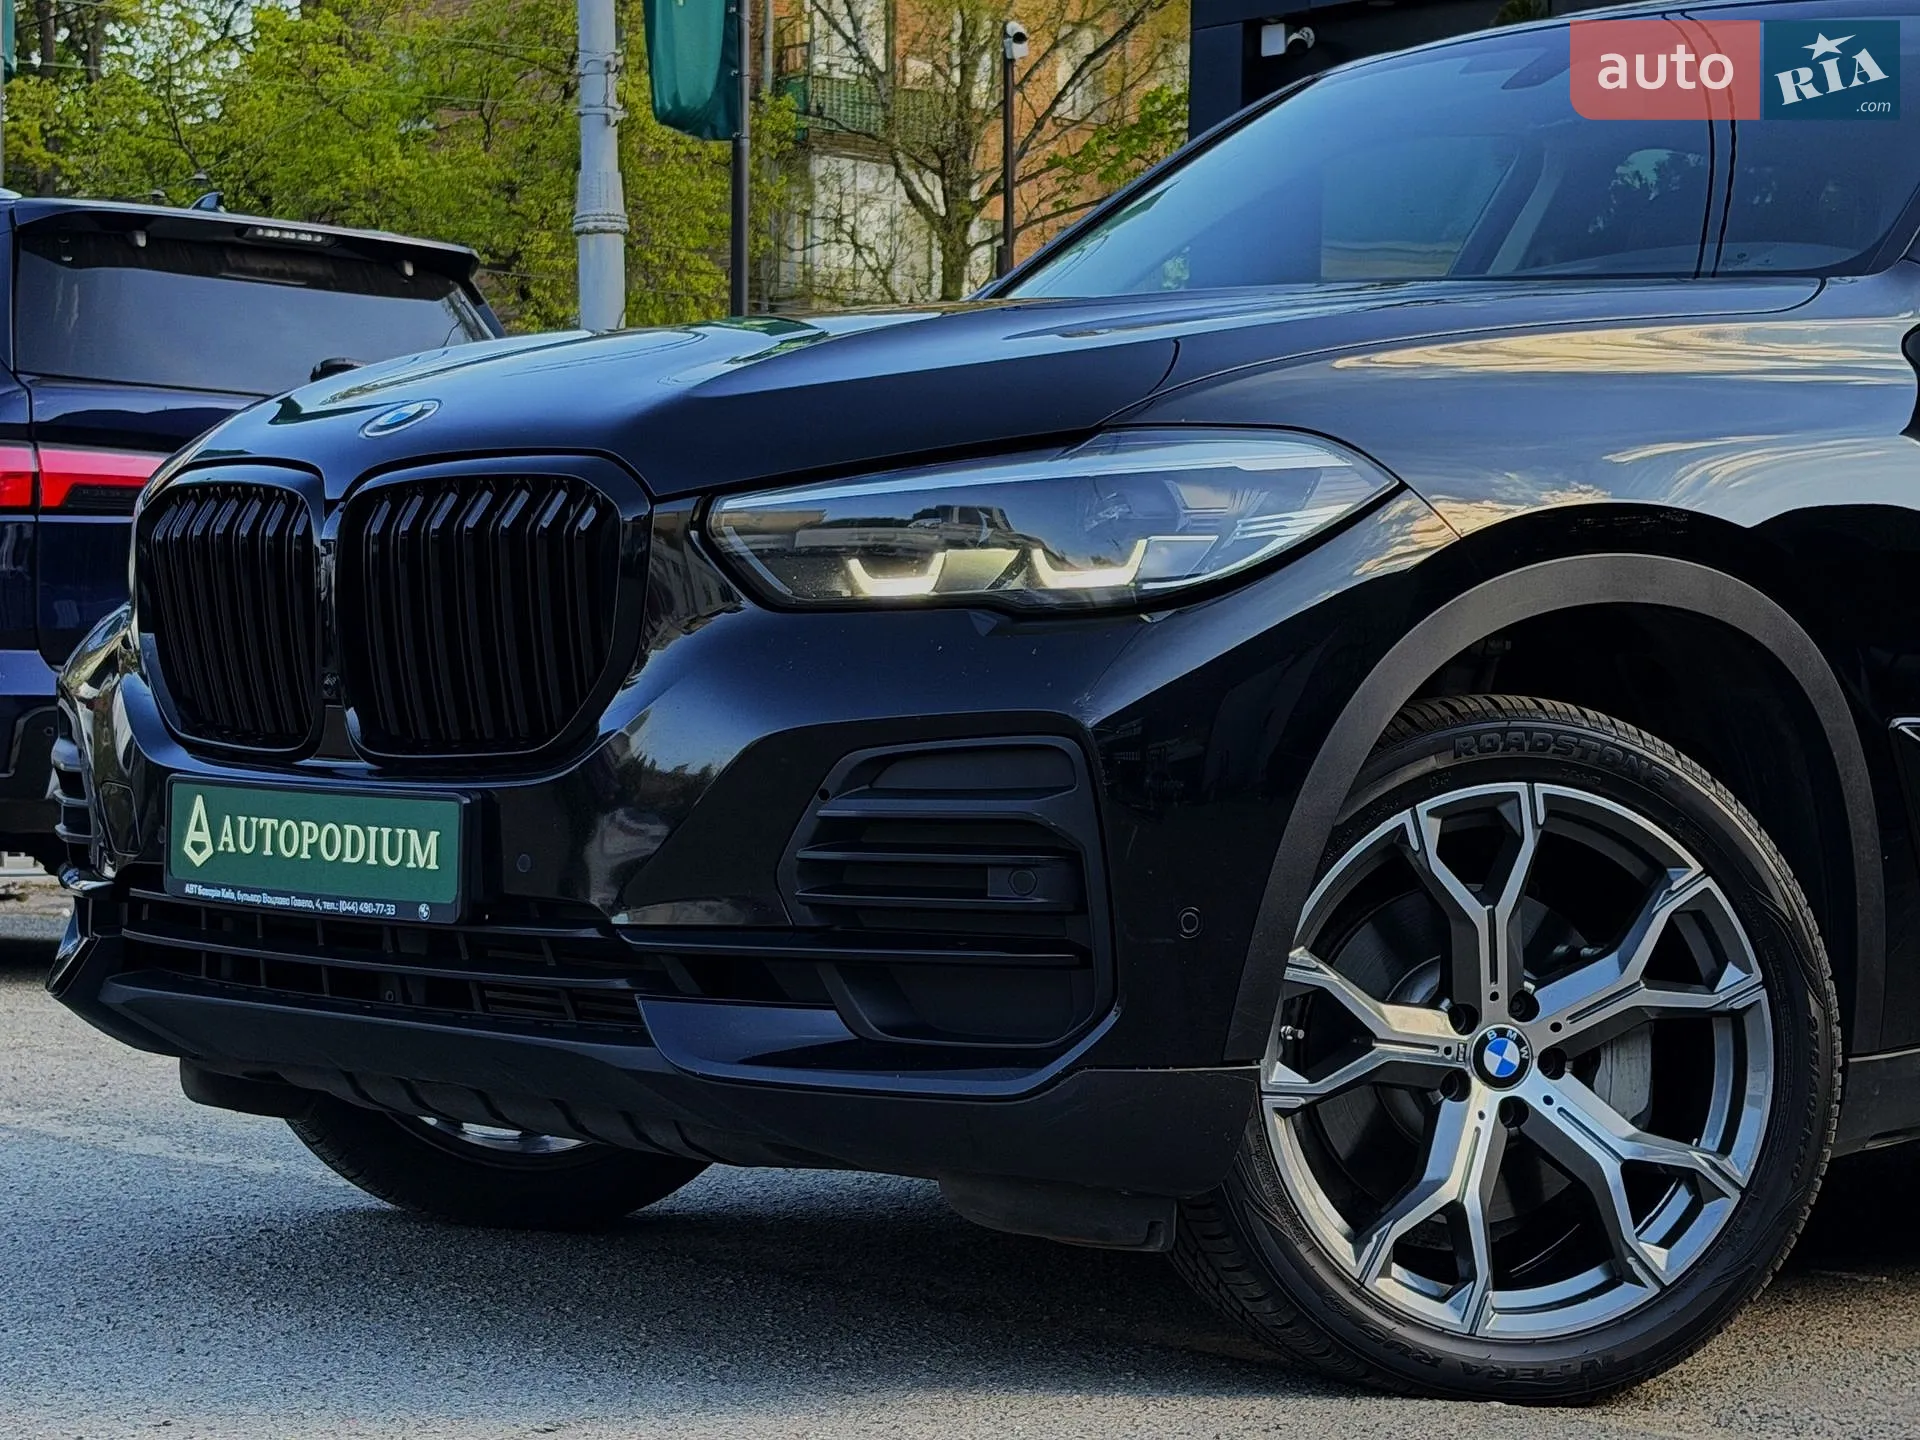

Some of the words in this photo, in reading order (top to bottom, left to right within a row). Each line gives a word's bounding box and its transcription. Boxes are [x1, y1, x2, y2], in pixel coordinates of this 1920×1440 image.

[1452, 731, 1671, 788] ROADSTONE
[217, 814, 441, 870] AUTOPODIUM
[339, 899, 359, 914] (044)
[359, 902, 396, 915] 490-77-33
[1486, 1029, 1530, 1060] BMW
